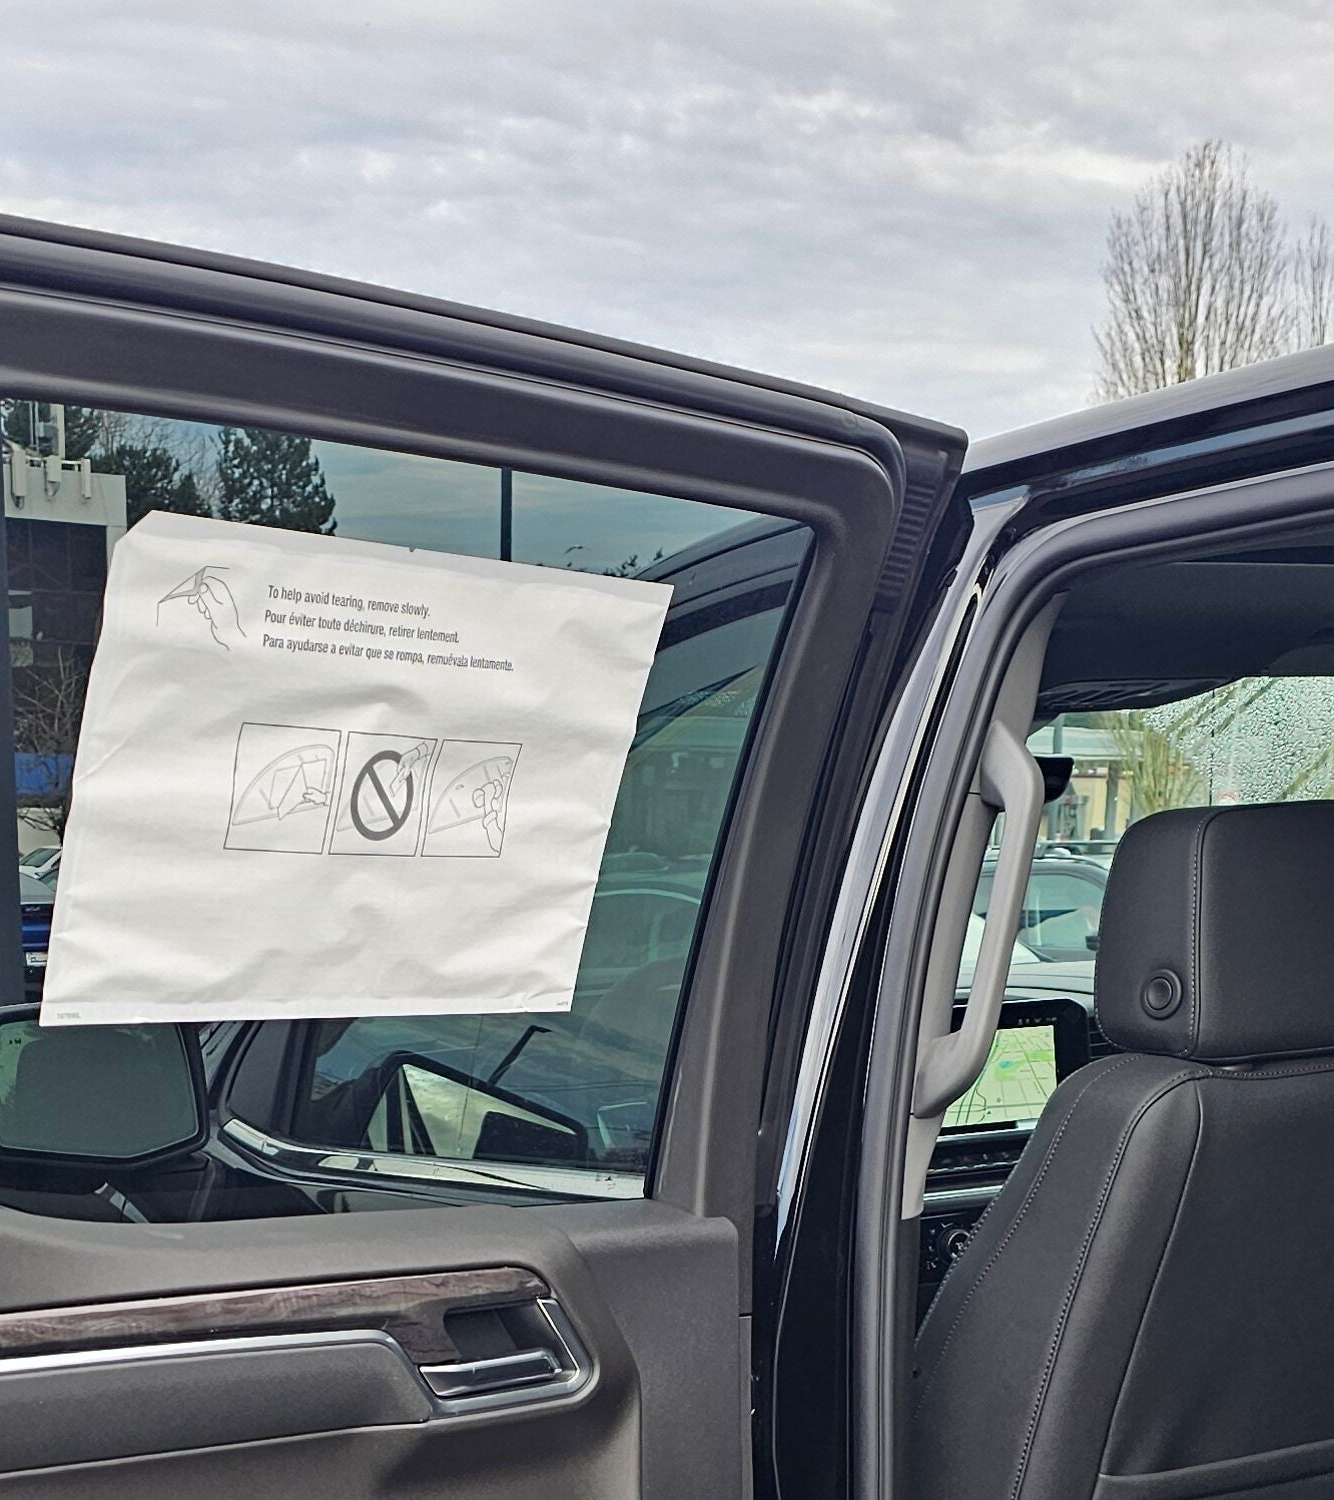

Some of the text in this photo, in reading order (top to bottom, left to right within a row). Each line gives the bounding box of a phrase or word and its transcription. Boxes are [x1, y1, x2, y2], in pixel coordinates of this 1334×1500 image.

[268, 584, 430, 620] To help avoid tearing, remove slowly.
[264, 609, 460, 644] Pour éviter toute déchirure, retirer lentement.
[262, 633, 514, 672] Para ayudarse a evitar que se rompa, remuévala lentamente.
